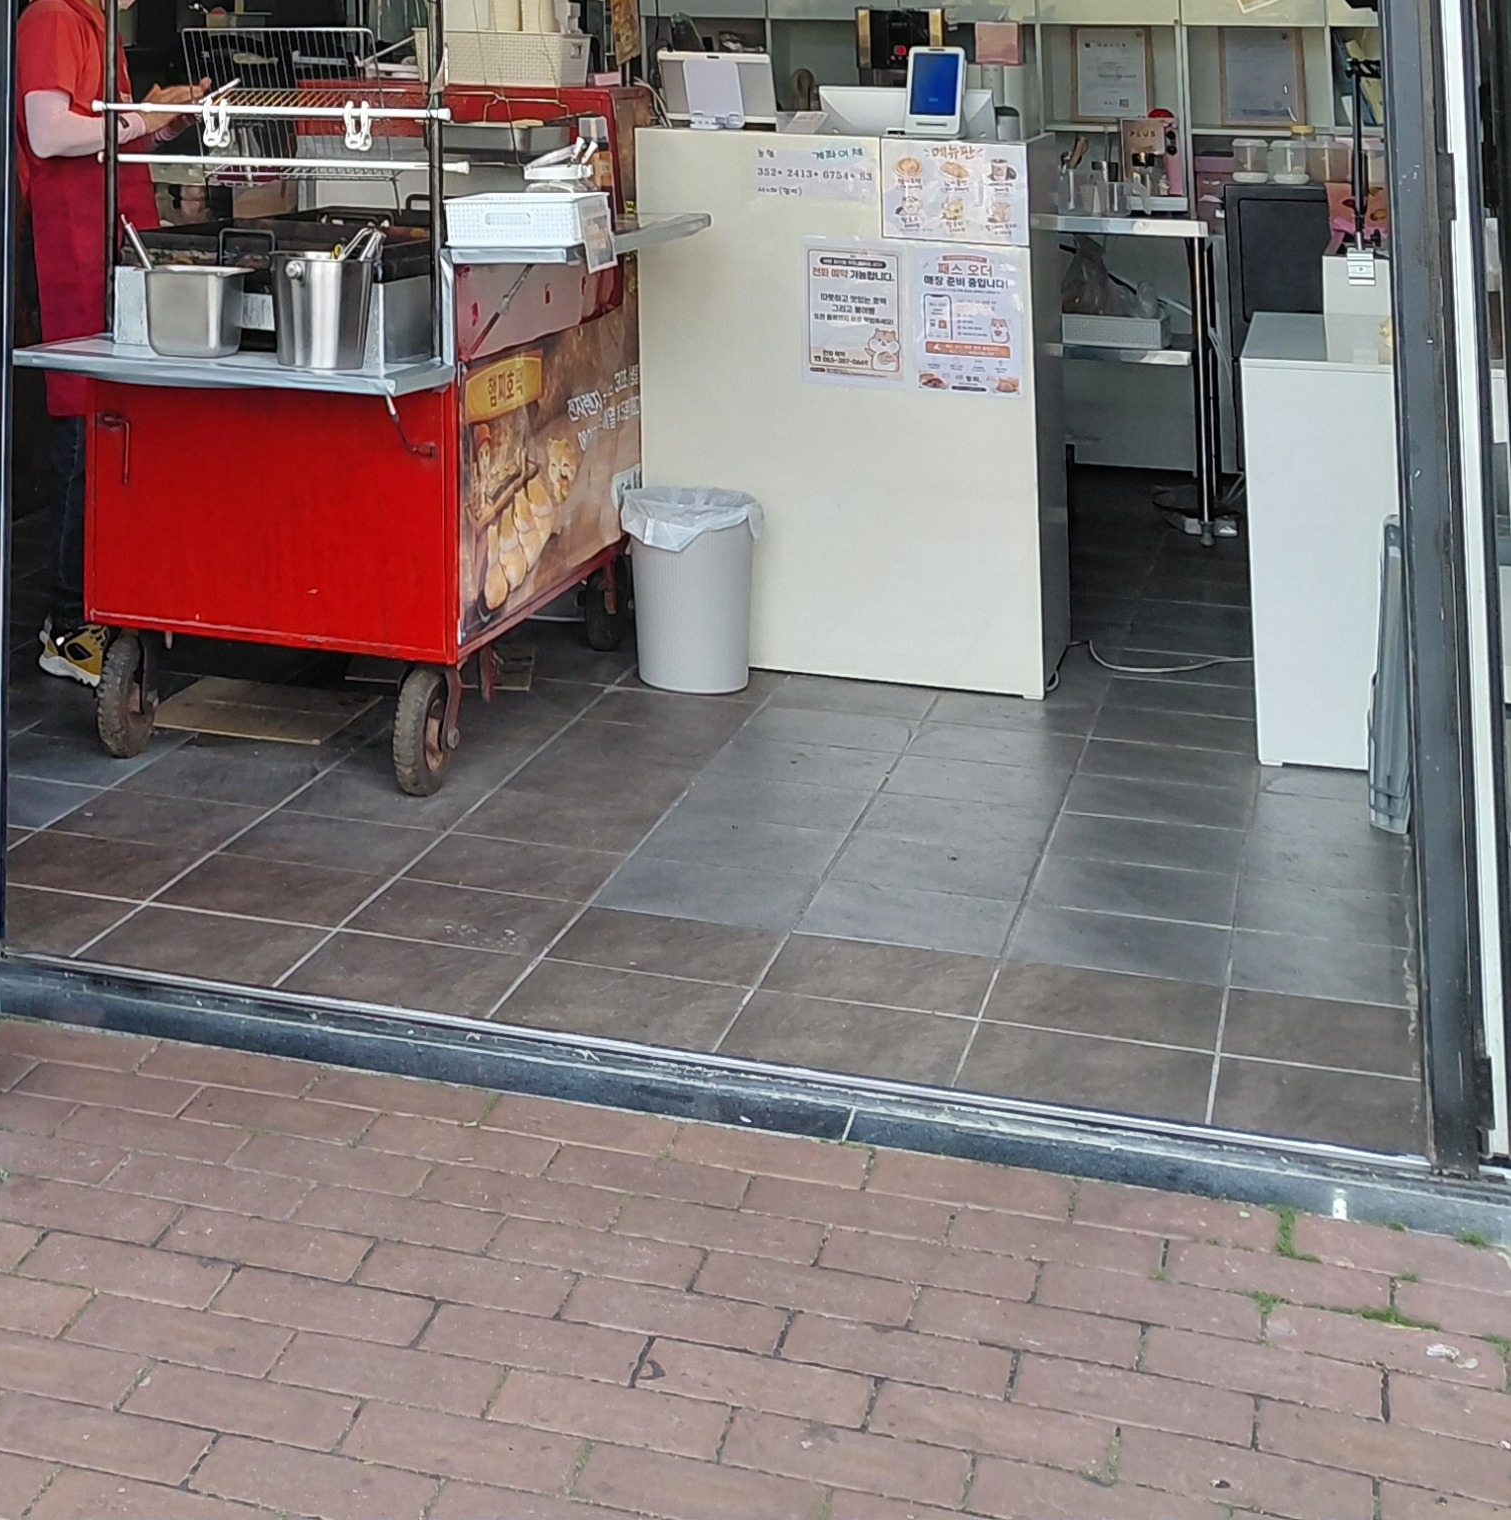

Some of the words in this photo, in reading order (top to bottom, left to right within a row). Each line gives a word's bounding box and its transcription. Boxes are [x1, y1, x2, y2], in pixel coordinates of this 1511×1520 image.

[1129, 130, 1157, 138] PLUS
[931, 144, 975, 160] 메뉴판
[812, 267, 829, 277] 전화
[831, 268, 849, 278] 예약
[938, 262, 963, 275] 패스
[967, 264, 993, 277] 오더
[923, 275, 944, 286] 매장
[946, 276, 966, 287] 준비
[967, 278, 1009, 290] 중입니다!
